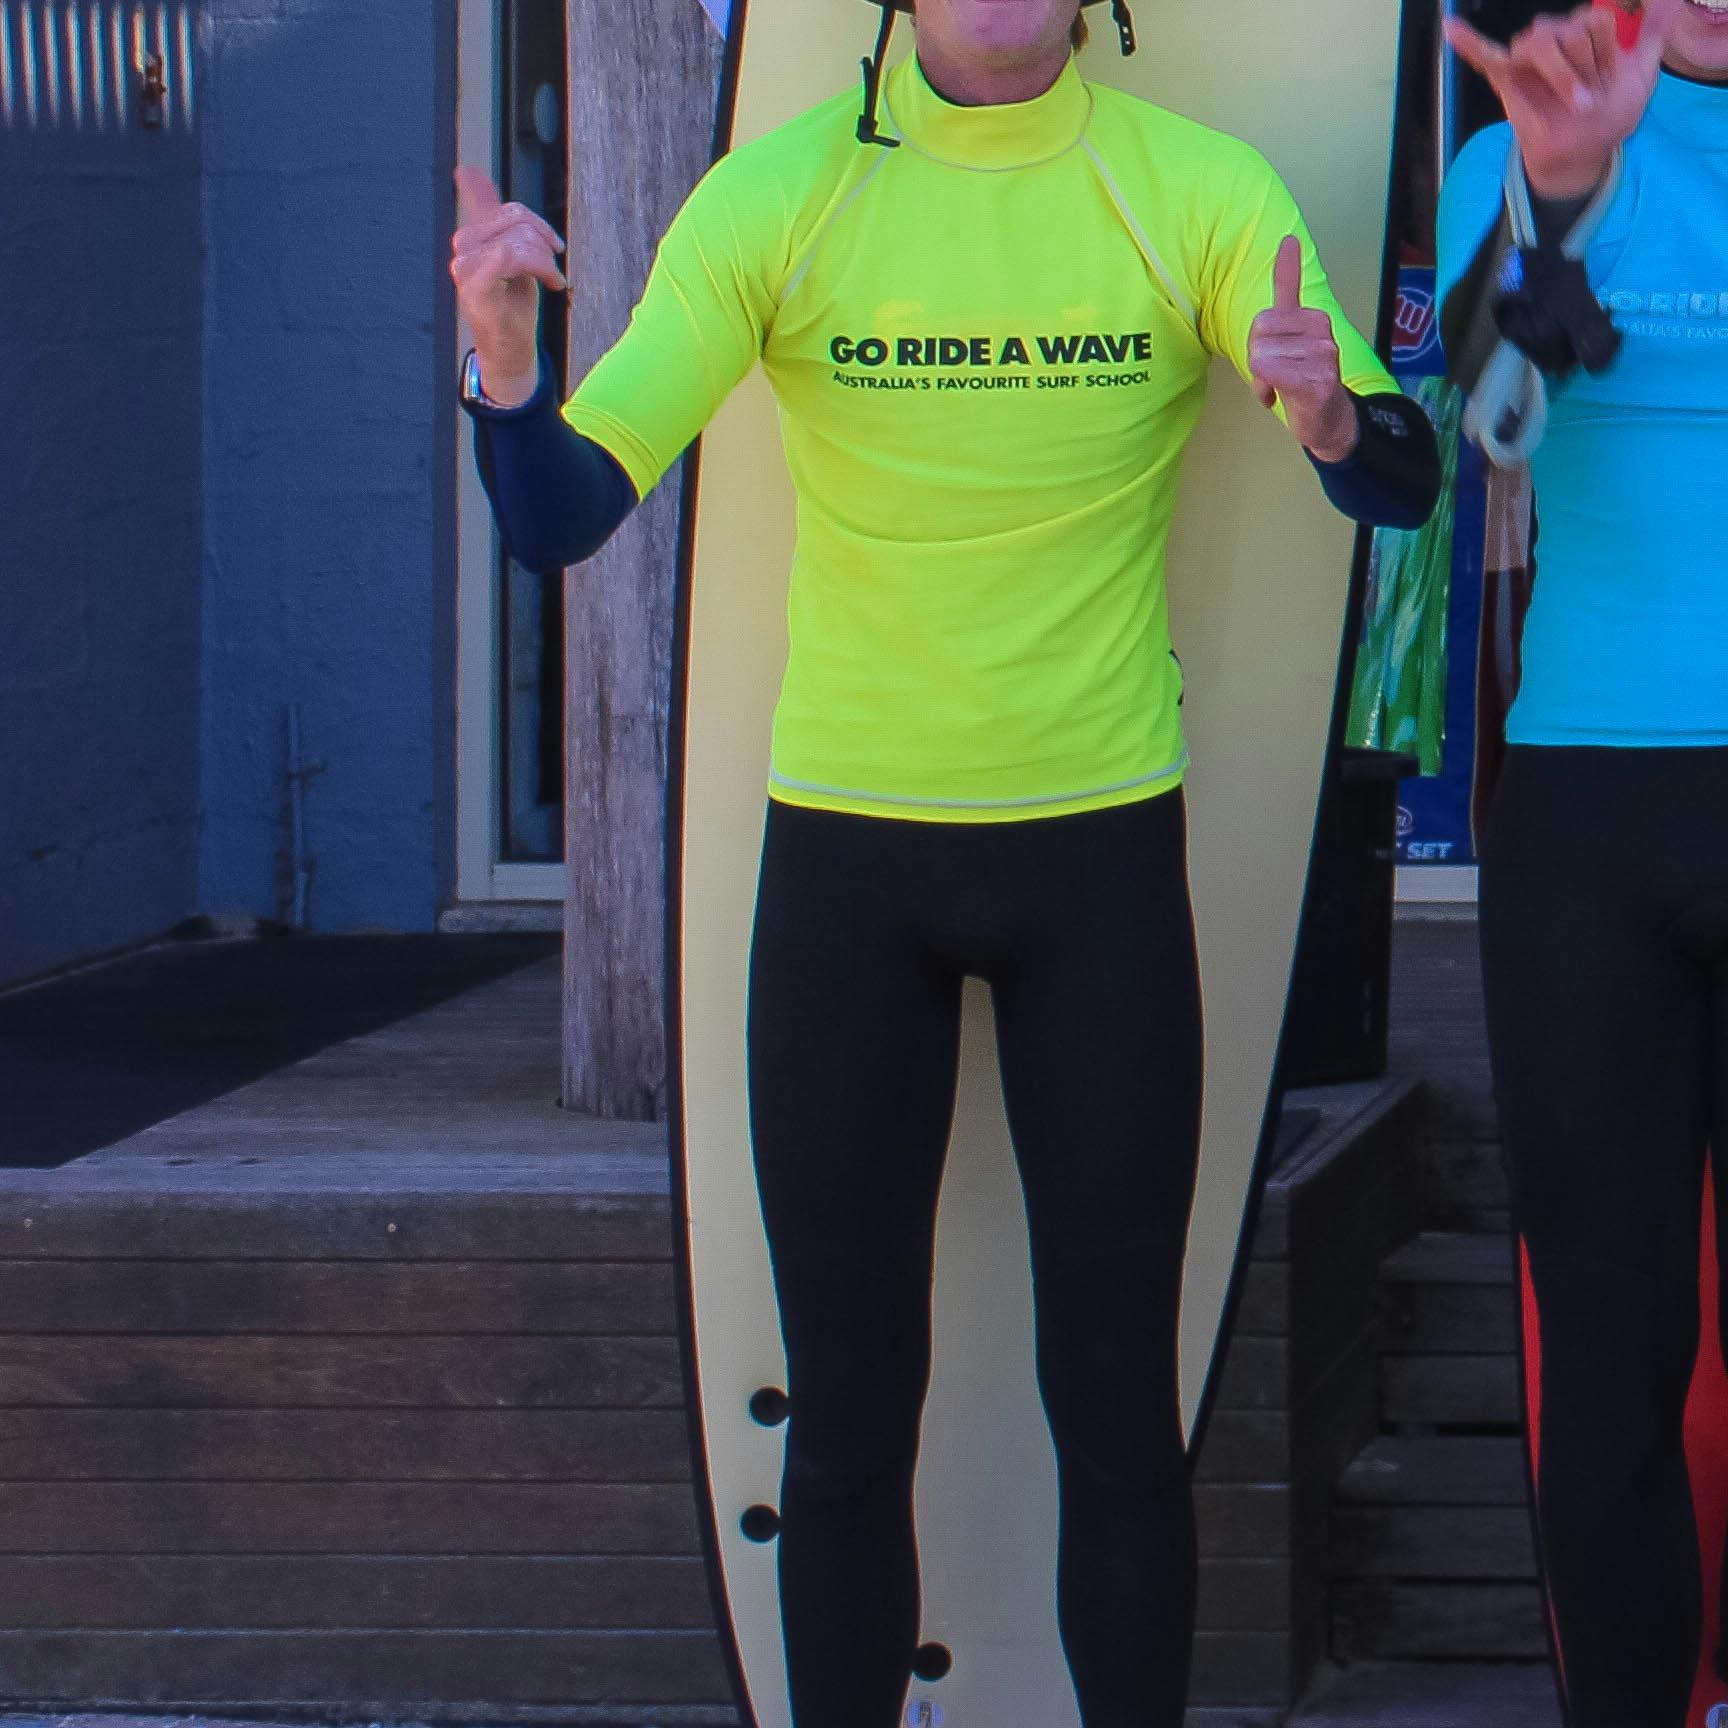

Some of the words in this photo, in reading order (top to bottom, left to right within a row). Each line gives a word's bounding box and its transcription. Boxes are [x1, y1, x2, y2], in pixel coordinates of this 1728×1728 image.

[830, 336, 889, 367] GO
[897, 336, 991, 366] RIDE
[1001, 336, 1031, 365] A
[1036, 332, 1153, 365] WAVE
[832, 370, 931, 391] AUSTRALIA'S
[937, 375, 1031, 391] FAVOURITE
[1036, 374, 1080, 390] SURF
[1086, 370, 1152, 388] SCHOOL
